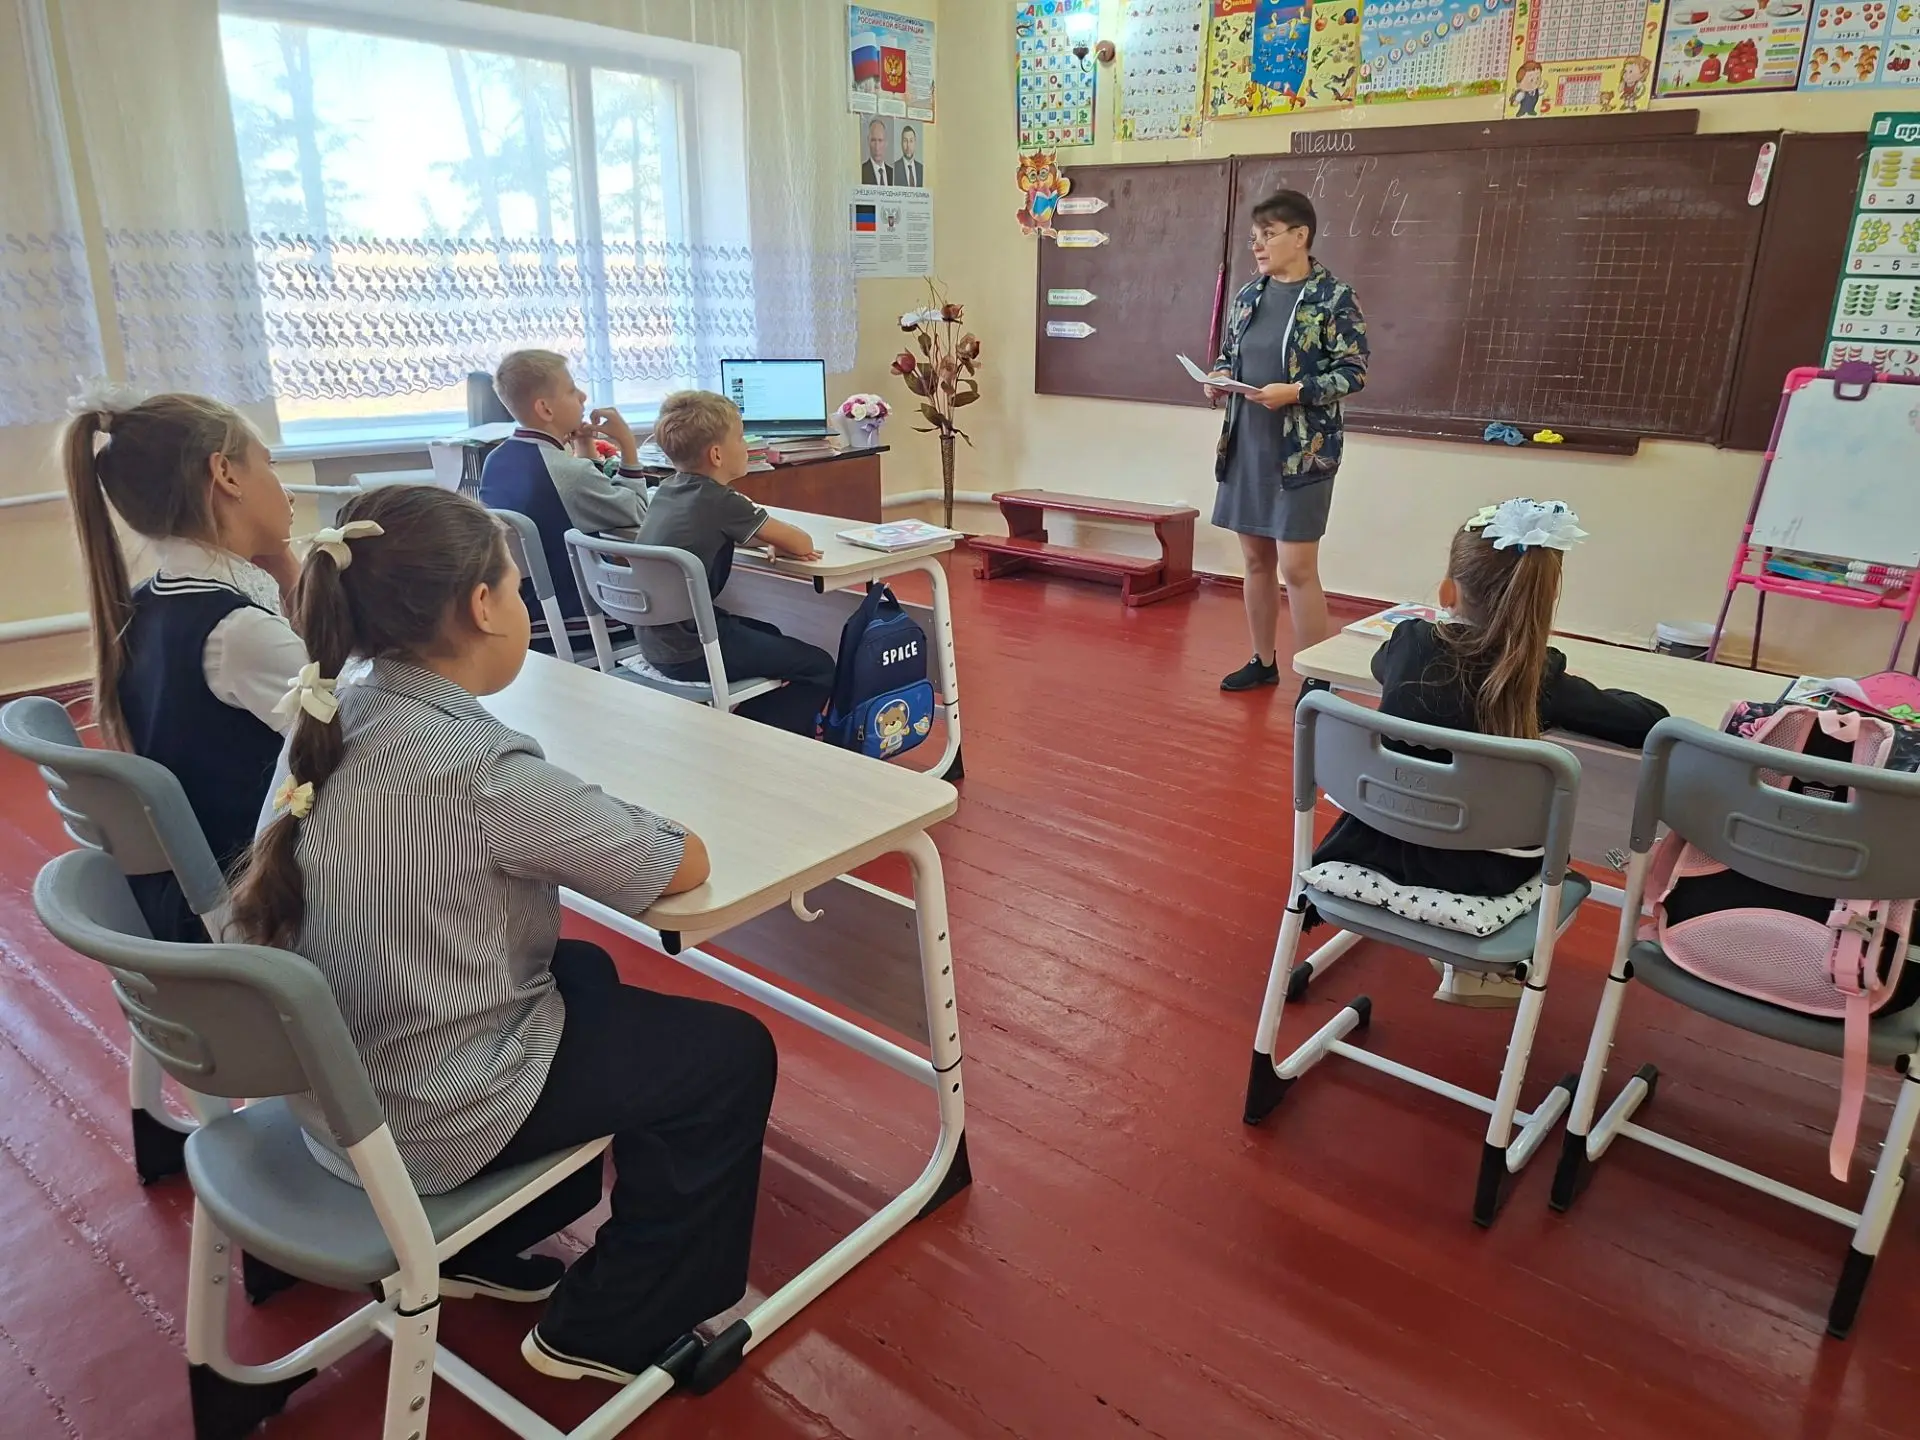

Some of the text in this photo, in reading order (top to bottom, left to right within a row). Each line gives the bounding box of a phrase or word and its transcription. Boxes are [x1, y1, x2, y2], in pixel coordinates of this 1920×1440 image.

[1519, 2, 1528, 17] 3
[1647, 21, 1658, 39] ?
[1515, 35, 1524, 51] ?
[1540, 98, 1551, 113] 5
[1868, 194, 1876, 205] 6
[1906, 193, 1915, 205] 3
[1854, 259, 1863, 270] 8
[1892, 260, 1901, 271] 5
[1839, 323, 1853, 333] 10
[1880, 325, 1888, 335] 3
[1915, 326, 1920, 336] 7
[882, 641, 918, 666] SPACE
